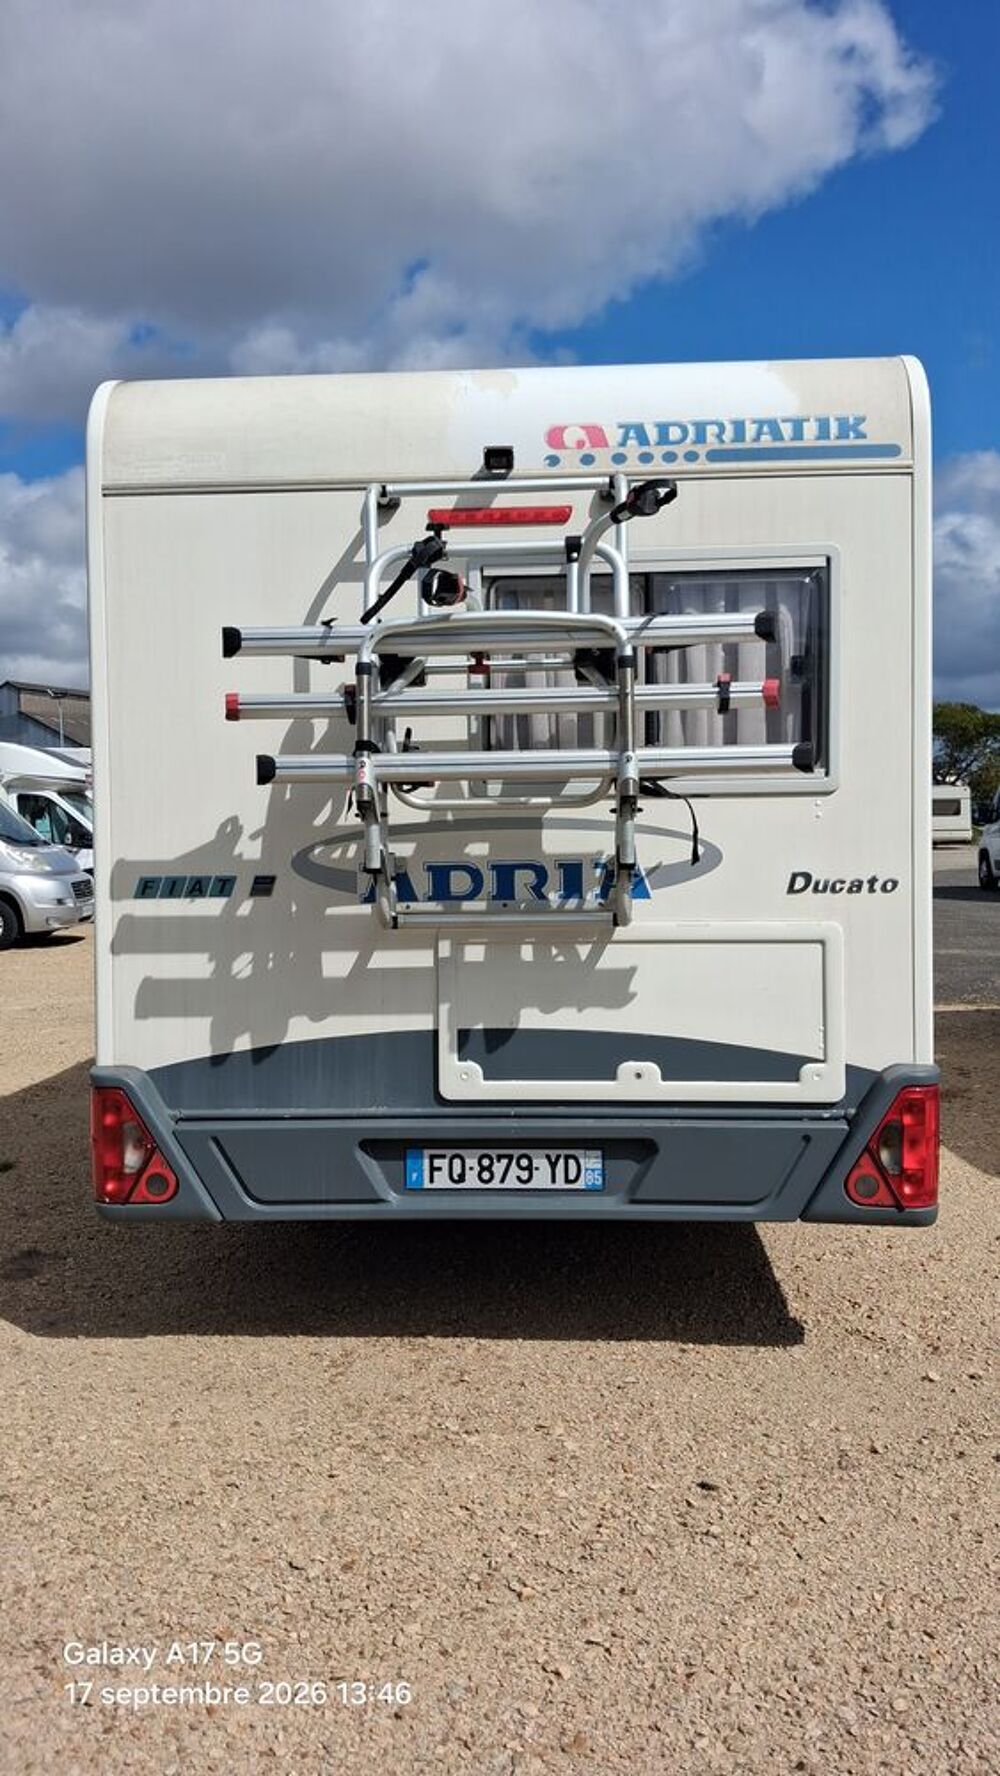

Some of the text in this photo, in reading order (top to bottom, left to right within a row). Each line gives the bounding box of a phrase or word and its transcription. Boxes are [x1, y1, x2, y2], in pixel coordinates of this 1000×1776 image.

[616, 414, 867, 447] ADRIATIK
[138, 877, 232, 897] FIAT
[786, 871, 899, 895] Ducato
[428, 1153, 582, 1185] FQ-879-YD
[585, 1169, 603, 1185] 85
